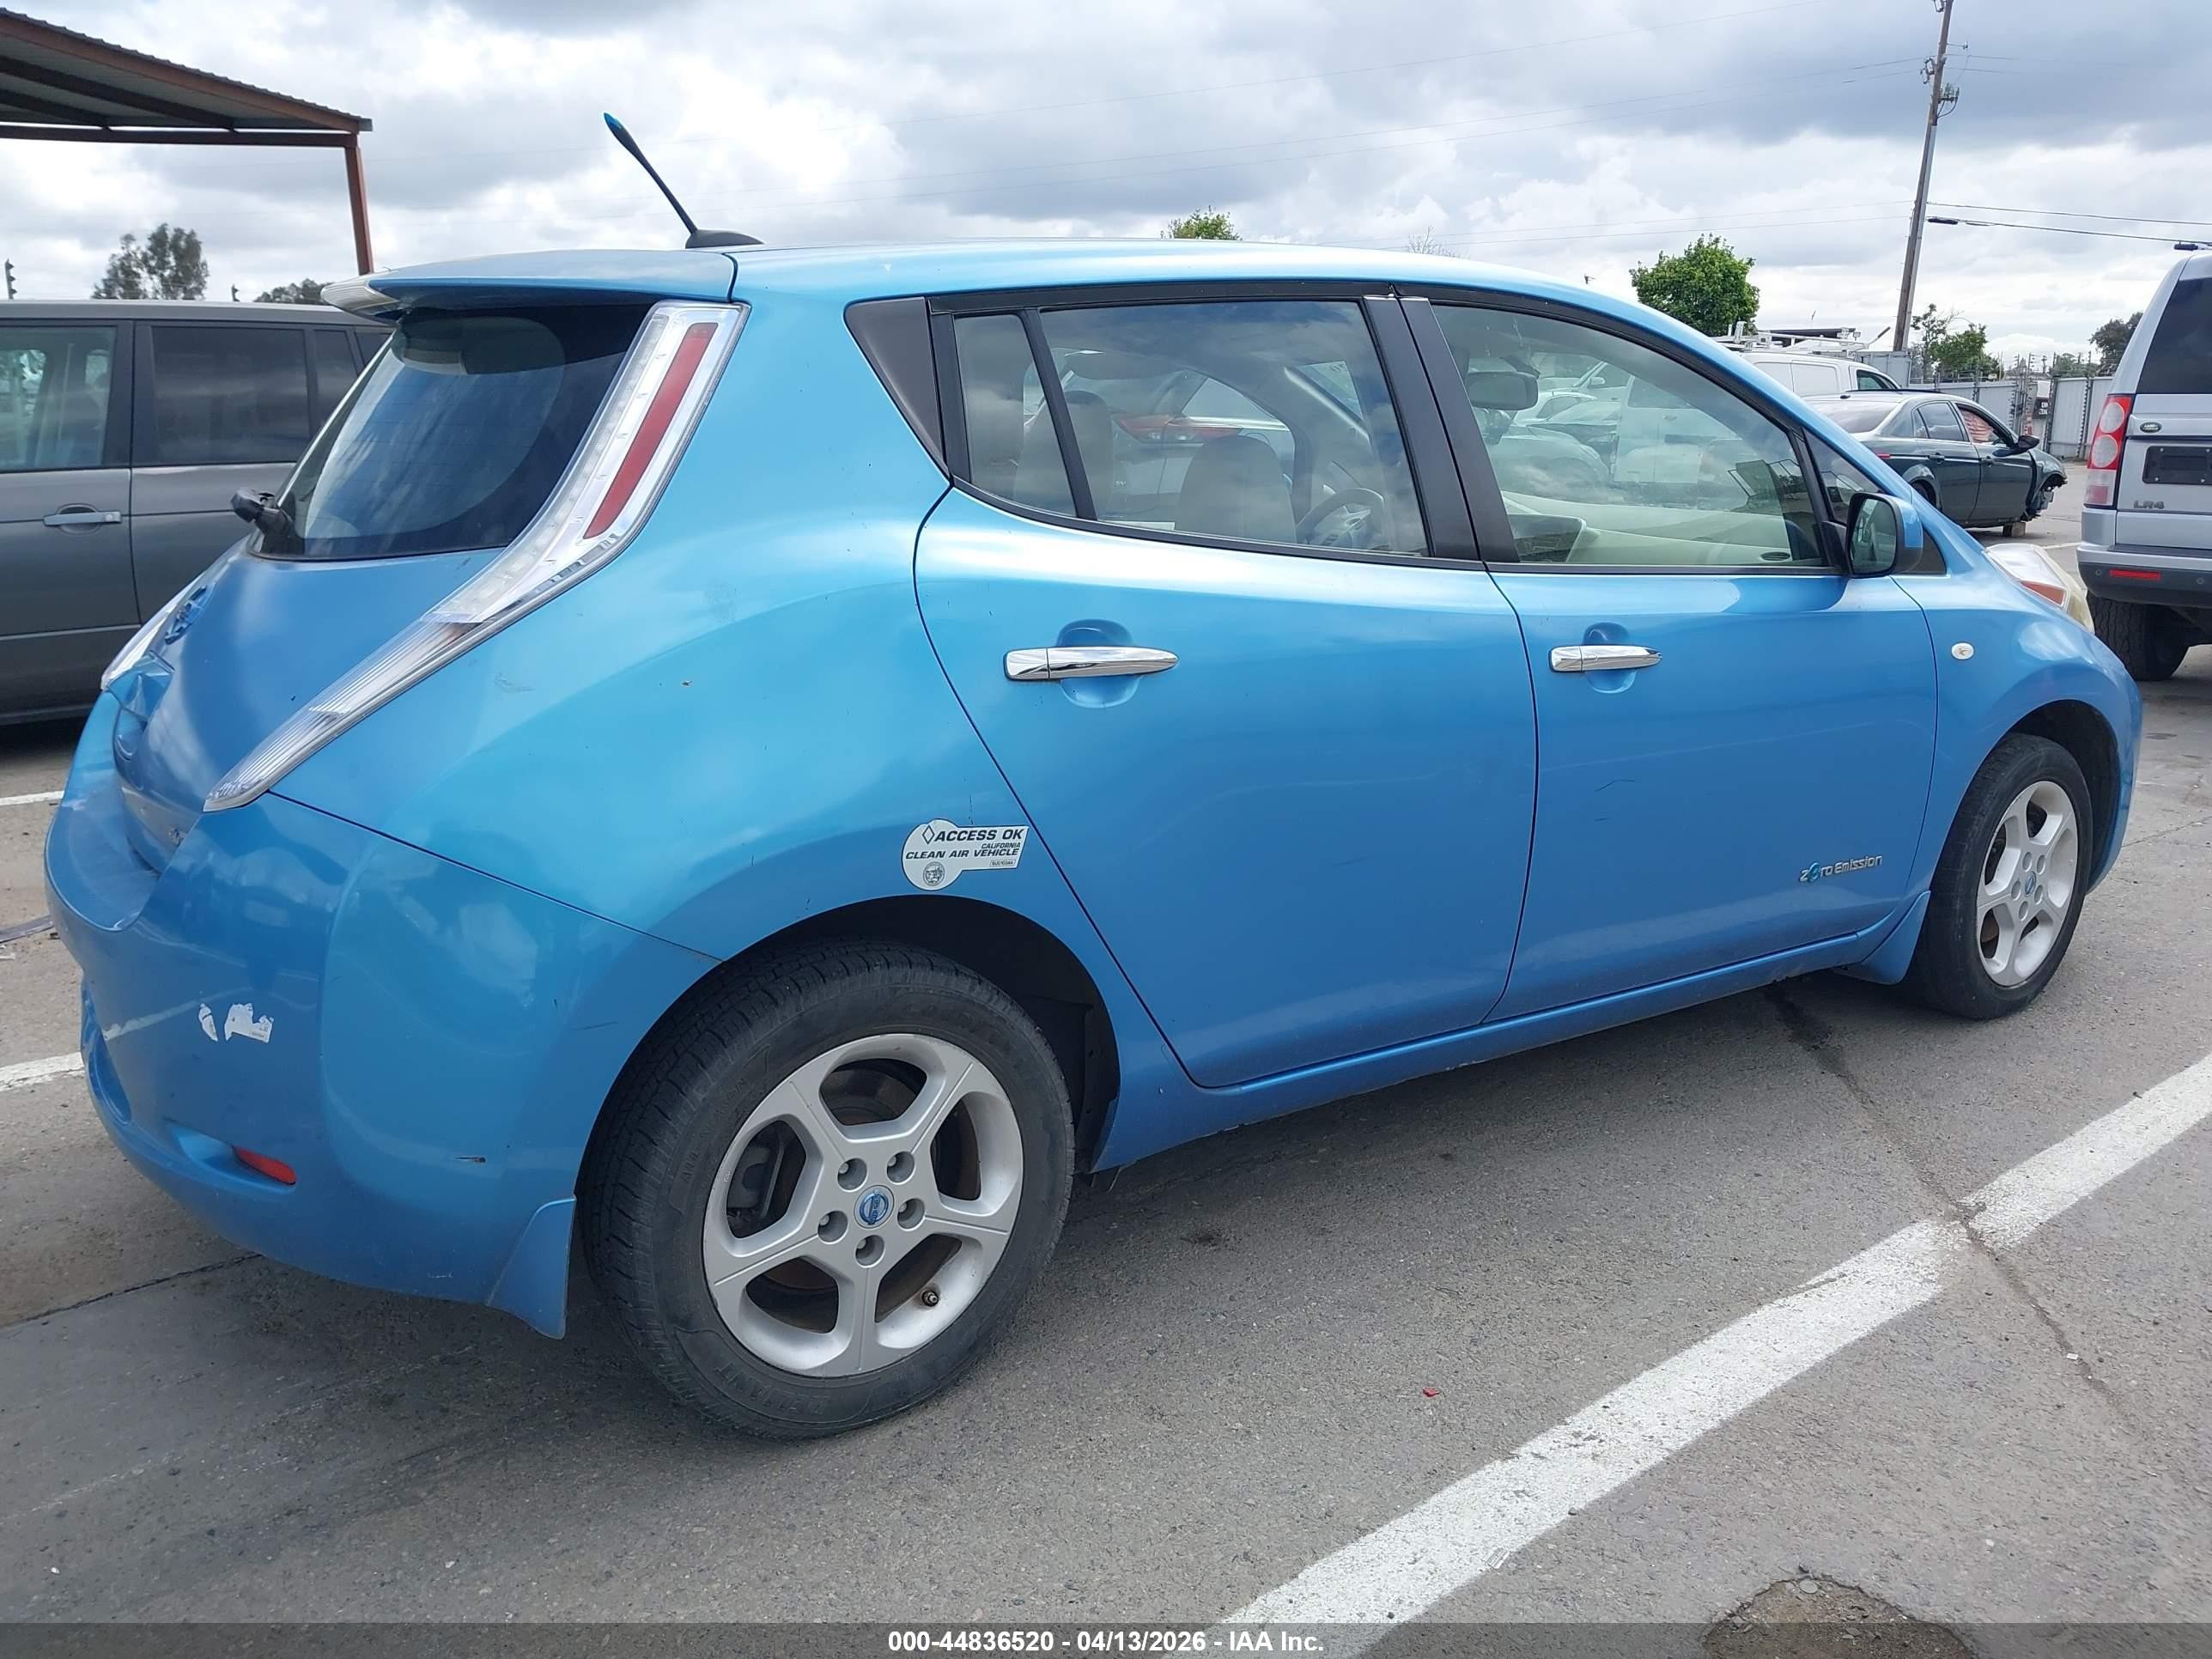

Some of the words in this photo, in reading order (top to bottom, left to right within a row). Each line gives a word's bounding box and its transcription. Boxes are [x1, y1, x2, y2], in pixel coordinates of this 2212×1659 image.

[2133, 500, 2165, 509] LR4
[934, 830, 998, 842] ACCESS
[1002, 829, 1024, 840] OK
[905, 851, 945, 860] CLEAN
[974, 848, 1019, 858] VEHICLE
